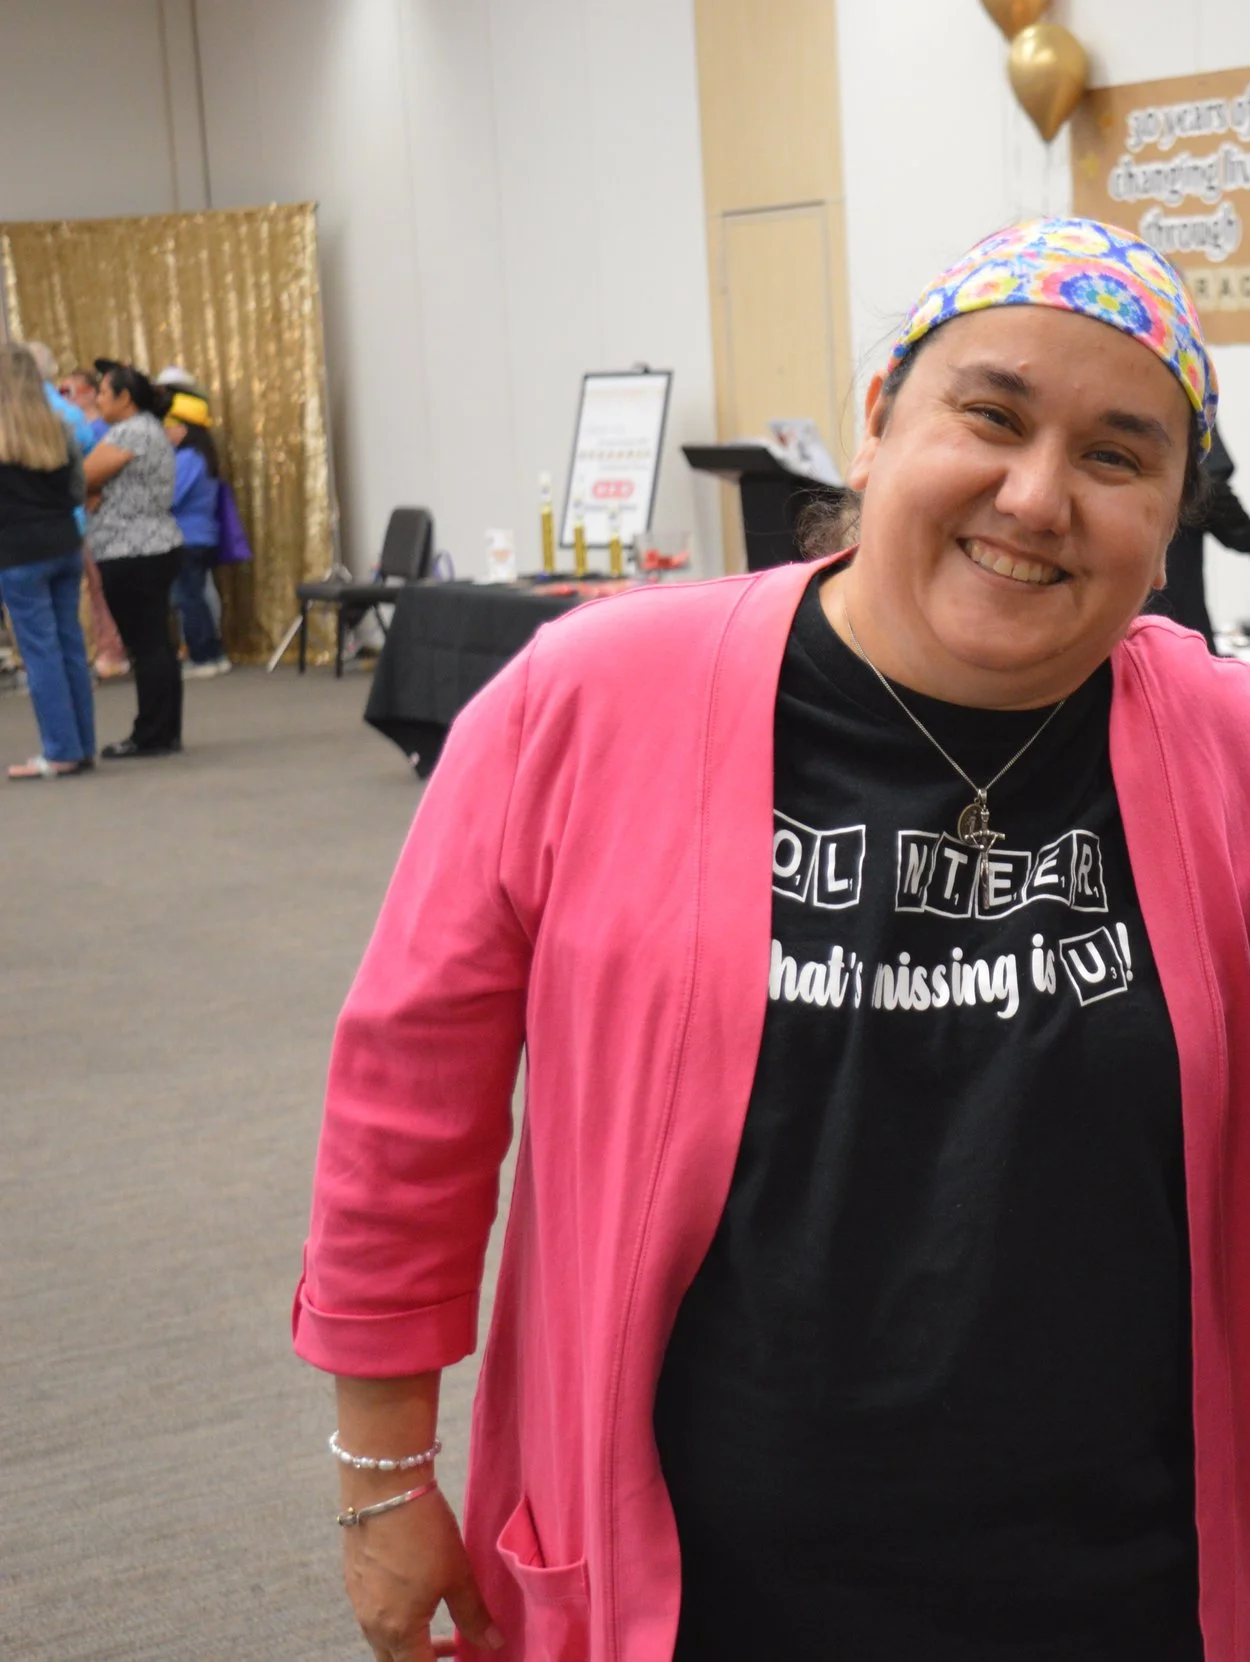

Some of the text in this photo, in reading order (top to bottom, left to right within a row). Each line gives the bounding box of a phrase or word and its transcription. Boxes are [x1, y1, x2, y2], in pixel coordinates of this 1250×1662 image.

[1161, 101, 1229, 149] years
[1109, 155, 1221, 204] changing
[773, 828, 852, 893] OL
[769, 938, 863, 1009] hat's
[1032, 933, 1057, 995] is
